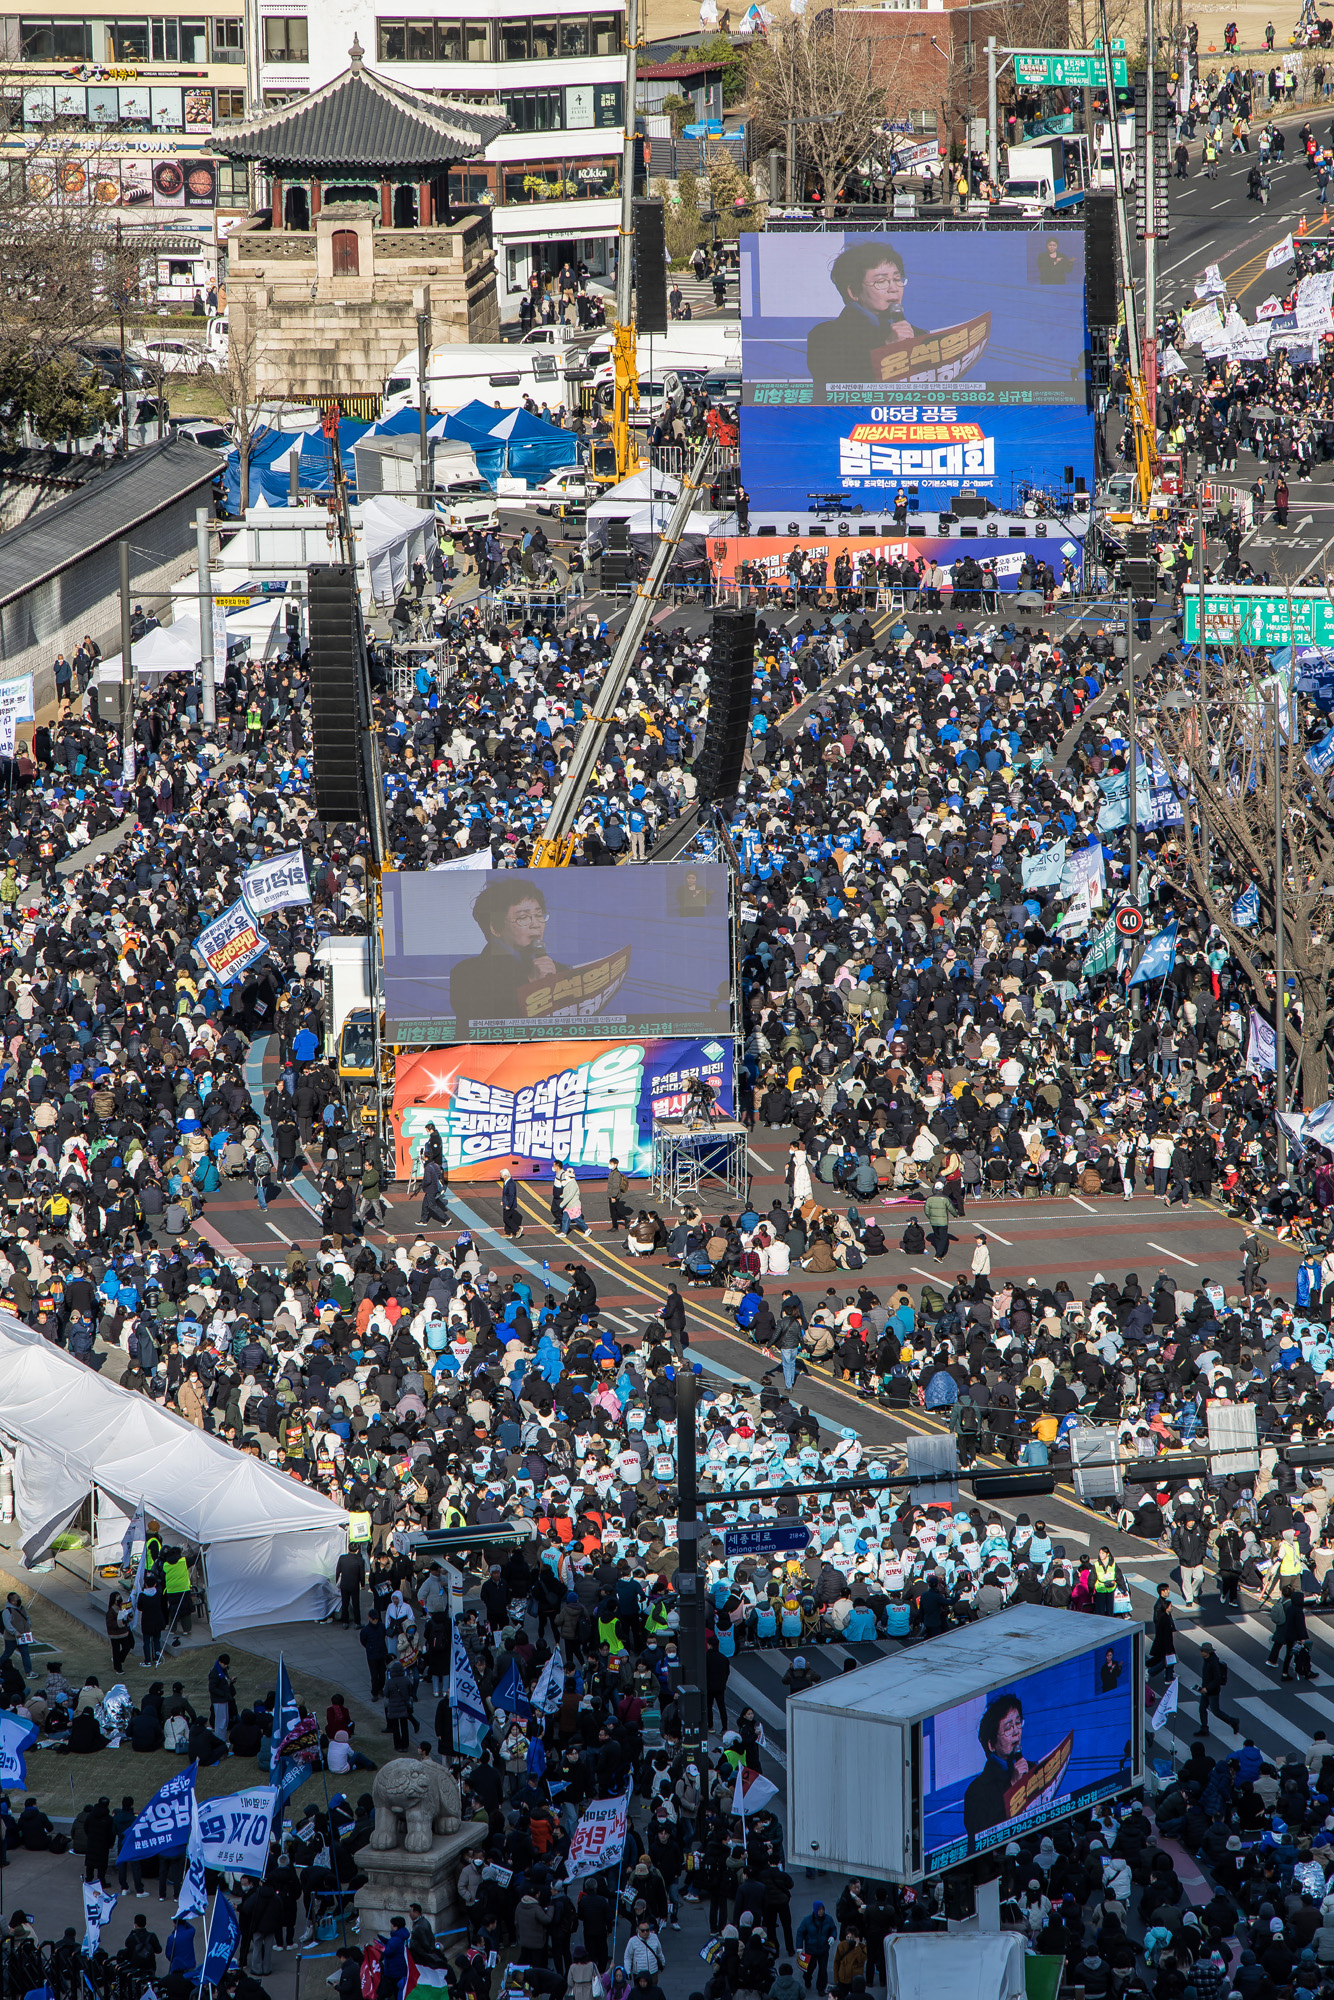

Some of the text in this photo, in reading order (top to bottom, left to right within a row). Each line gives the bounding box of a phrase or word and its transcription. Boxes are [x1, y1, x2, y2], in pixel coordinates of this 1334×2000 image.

[134, 142, 171, 152] TOWN
[881, 322, 987, 380] 윤석열을
[754, 388, 813, 404] 비상행동
[826, 391, 885, 403] 카카오뱅크
[887, 392, 995, 402] 7942-09-53862
[870, 406, 958, 422] 야5당 공동
[853, 425, 982, 440] 비상시국 대응을 위한
[839, 436, 995, 475] 범국민대회
[1122, 914, 1137, 927] 40
[526, 955, 627, 1017] 윤석열을
[396, 1026, 457, 1042] 비상행동
[468, 1027, 527, 1040] 카카오뱅크
[529, 1023, 636, 1037] 7942-09-53862
[651, 1071, 678, 1087] 윤석열
[701, 1062, 724, 1076] 퇴진!
[455, 1047, 639, 1122] 모든 윤석열을
[409, 1108, 513, 1135] 주권자의
[514, 1107, 636, 1169] 파면하자
[728, 1532, 772, 1545] 세종대로
[727, 1543, 777, 1554] Sejong-daero
[975, 1828, 1011, 1851] 카카오뱅크
[1011, 1801, 1076, 1836] 7942-09-53862
[930, 1842, 968, 1872] 비상행동
